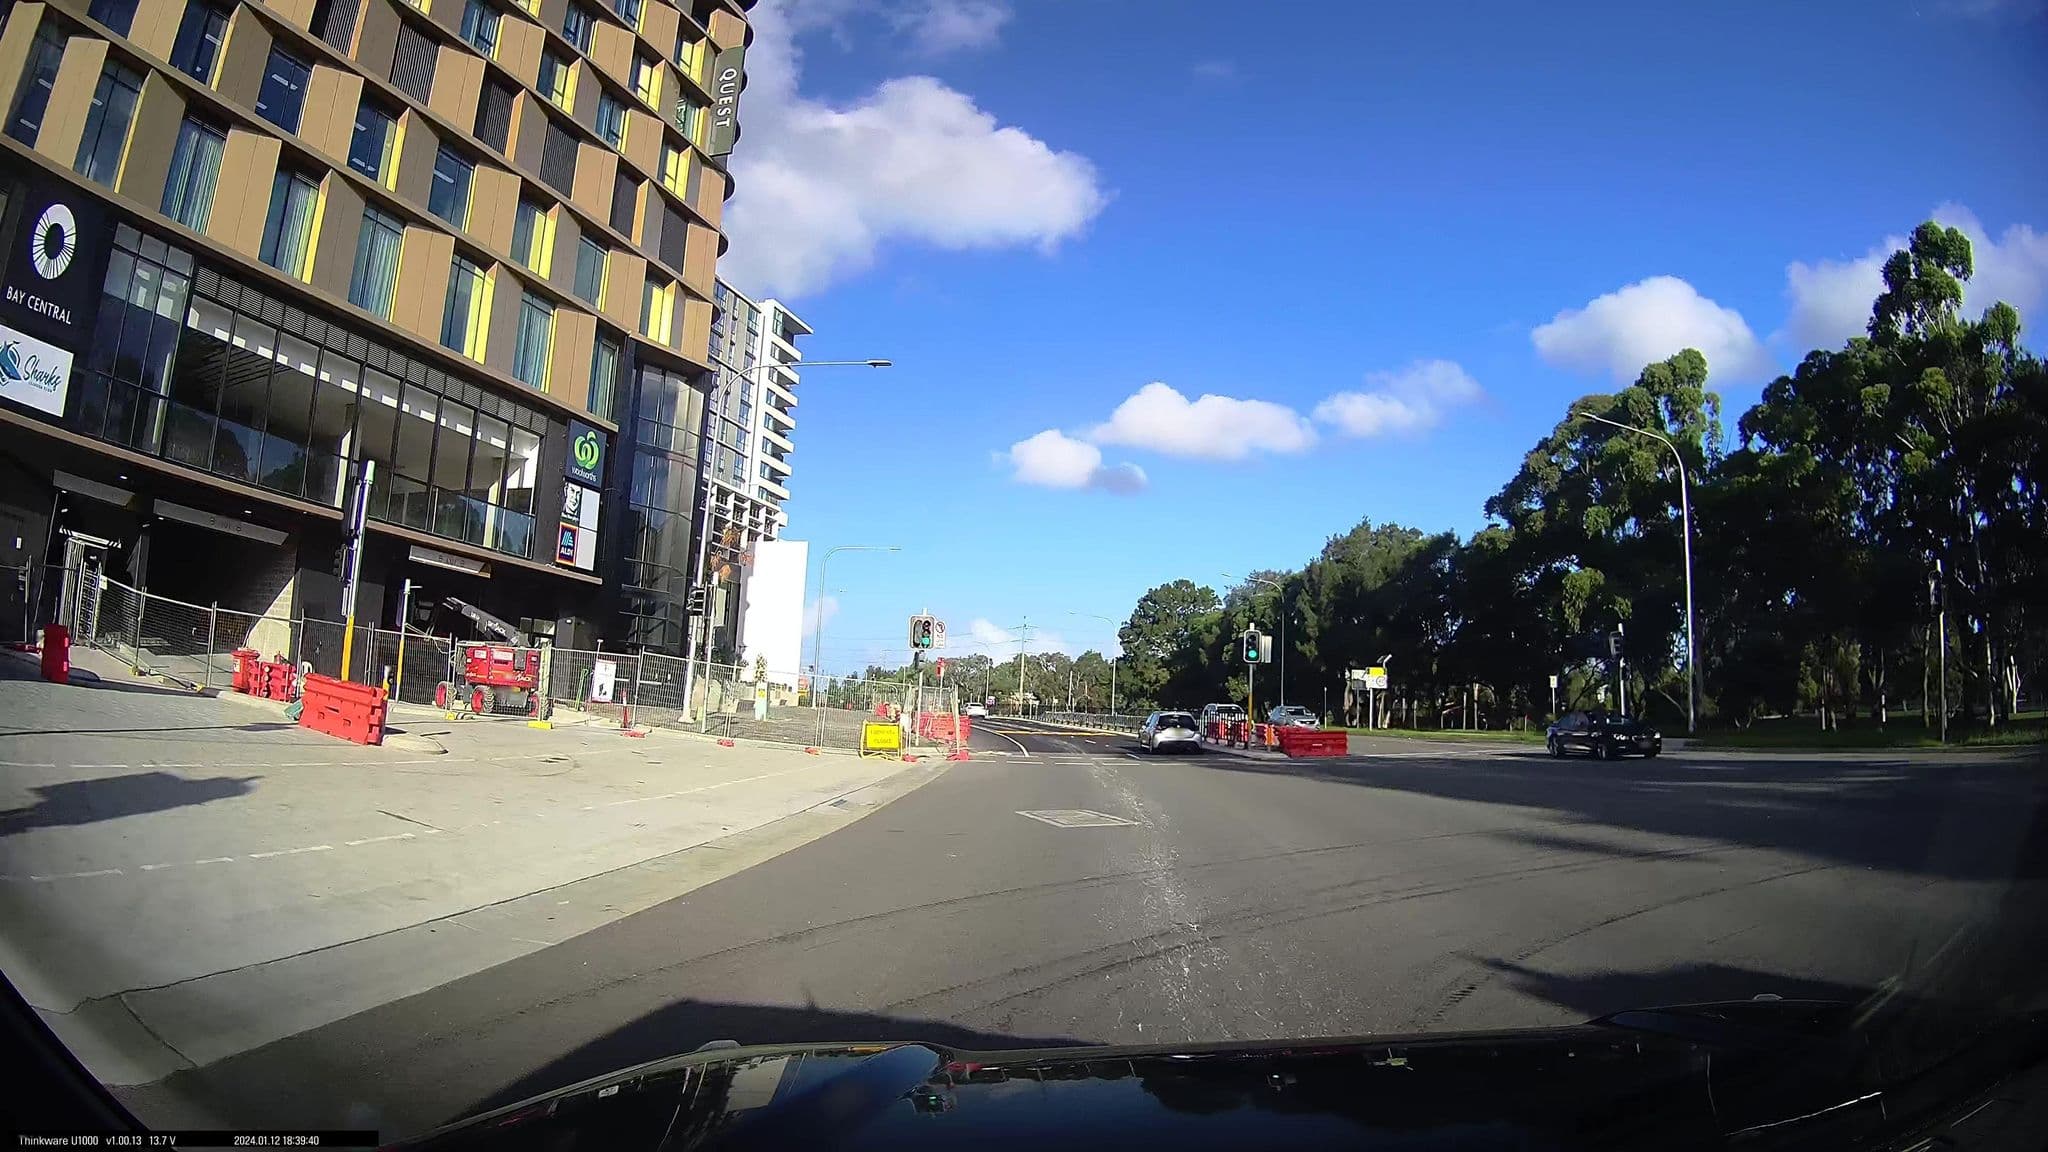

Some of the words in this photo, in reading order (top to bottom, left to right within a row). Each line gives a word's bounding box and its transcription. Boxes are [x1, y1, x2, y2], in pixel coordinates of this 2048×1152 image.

[716, 68, 737, 127] QUEST
[6, 286, 25, 304] BAY
[27, 295, 72, 325] CENTRAL
[23, 354, 62, 391] Sharks
[560, 546, 574, 556] ALDI
